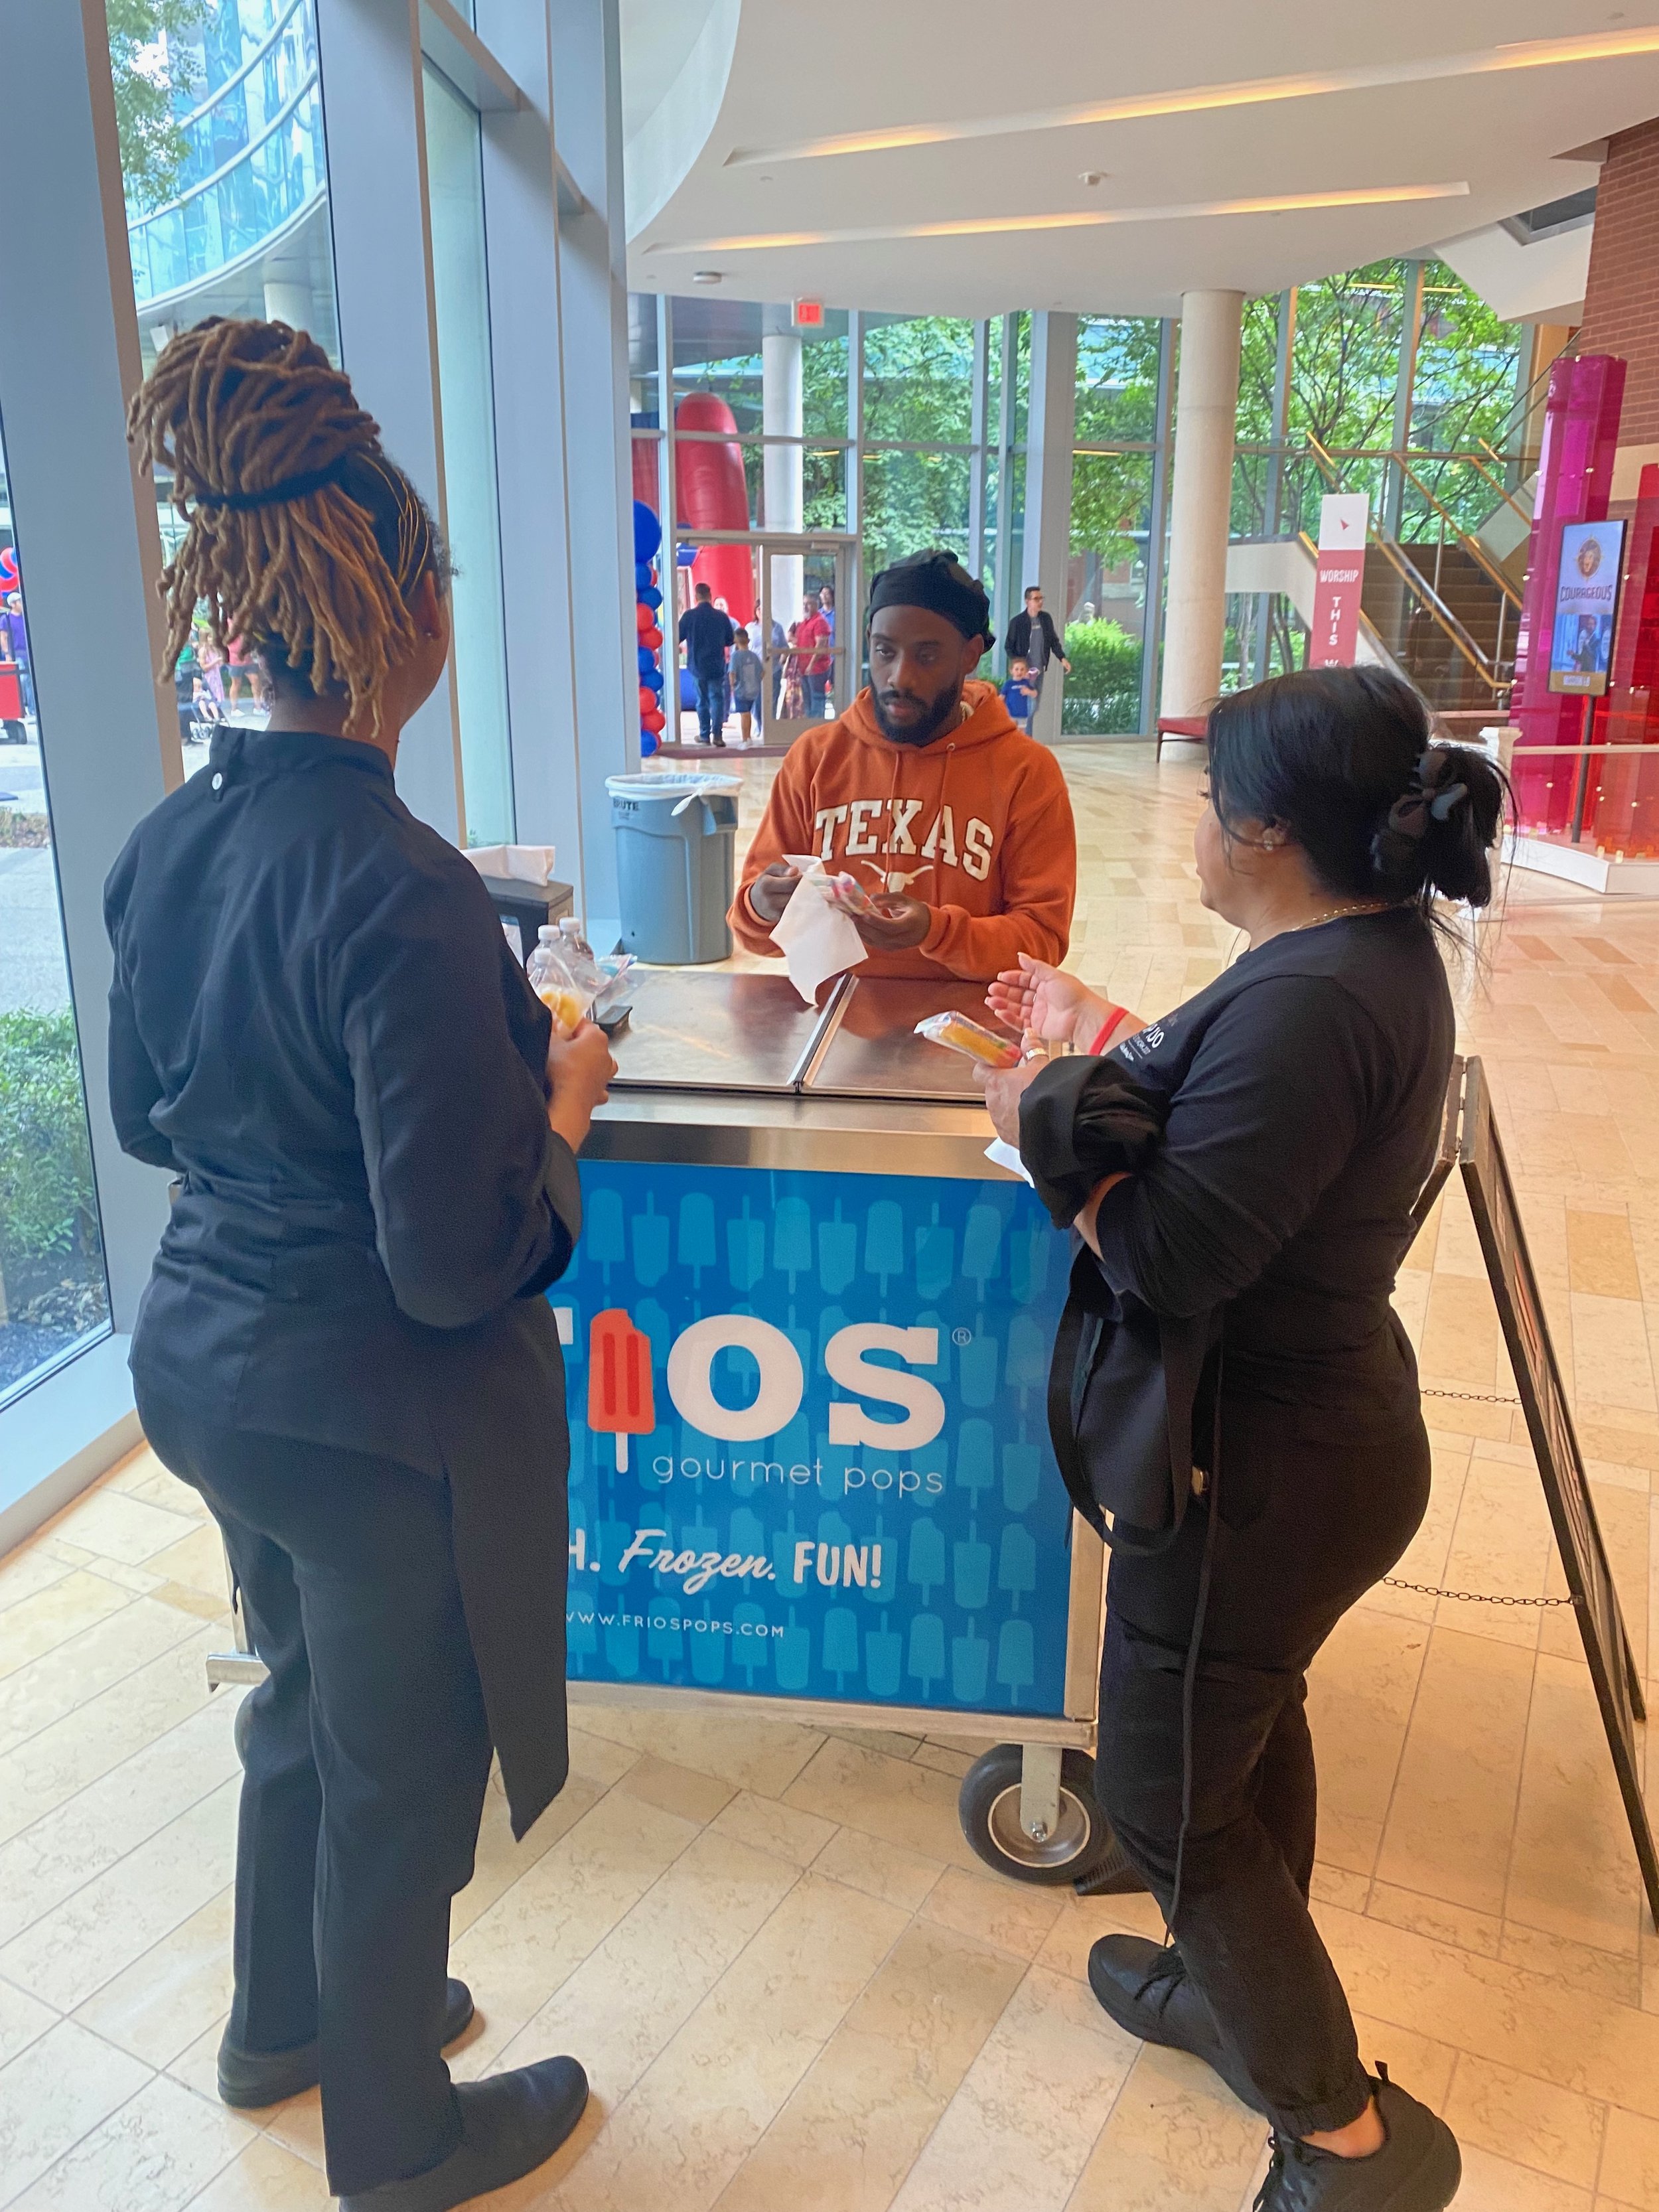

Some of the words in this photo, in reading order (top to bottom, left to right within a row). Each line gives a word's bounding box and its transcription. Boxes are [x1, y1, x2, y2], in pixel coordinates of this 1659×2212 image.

[1320, 569, 1359, 583] WORSHIP
[1560, 584, 1613, 602] COURAGEOUS
[1329, 596, 1342, 646] THIS
[815, 798, 994, 882] TEXAS
[652, 1455, 824, 1486] gourmet
[844, 1467, 943, 1499] pops
[618, 1528, 776, 1595] Frozen.
[793, 1541, 882, 1588] FUN!
